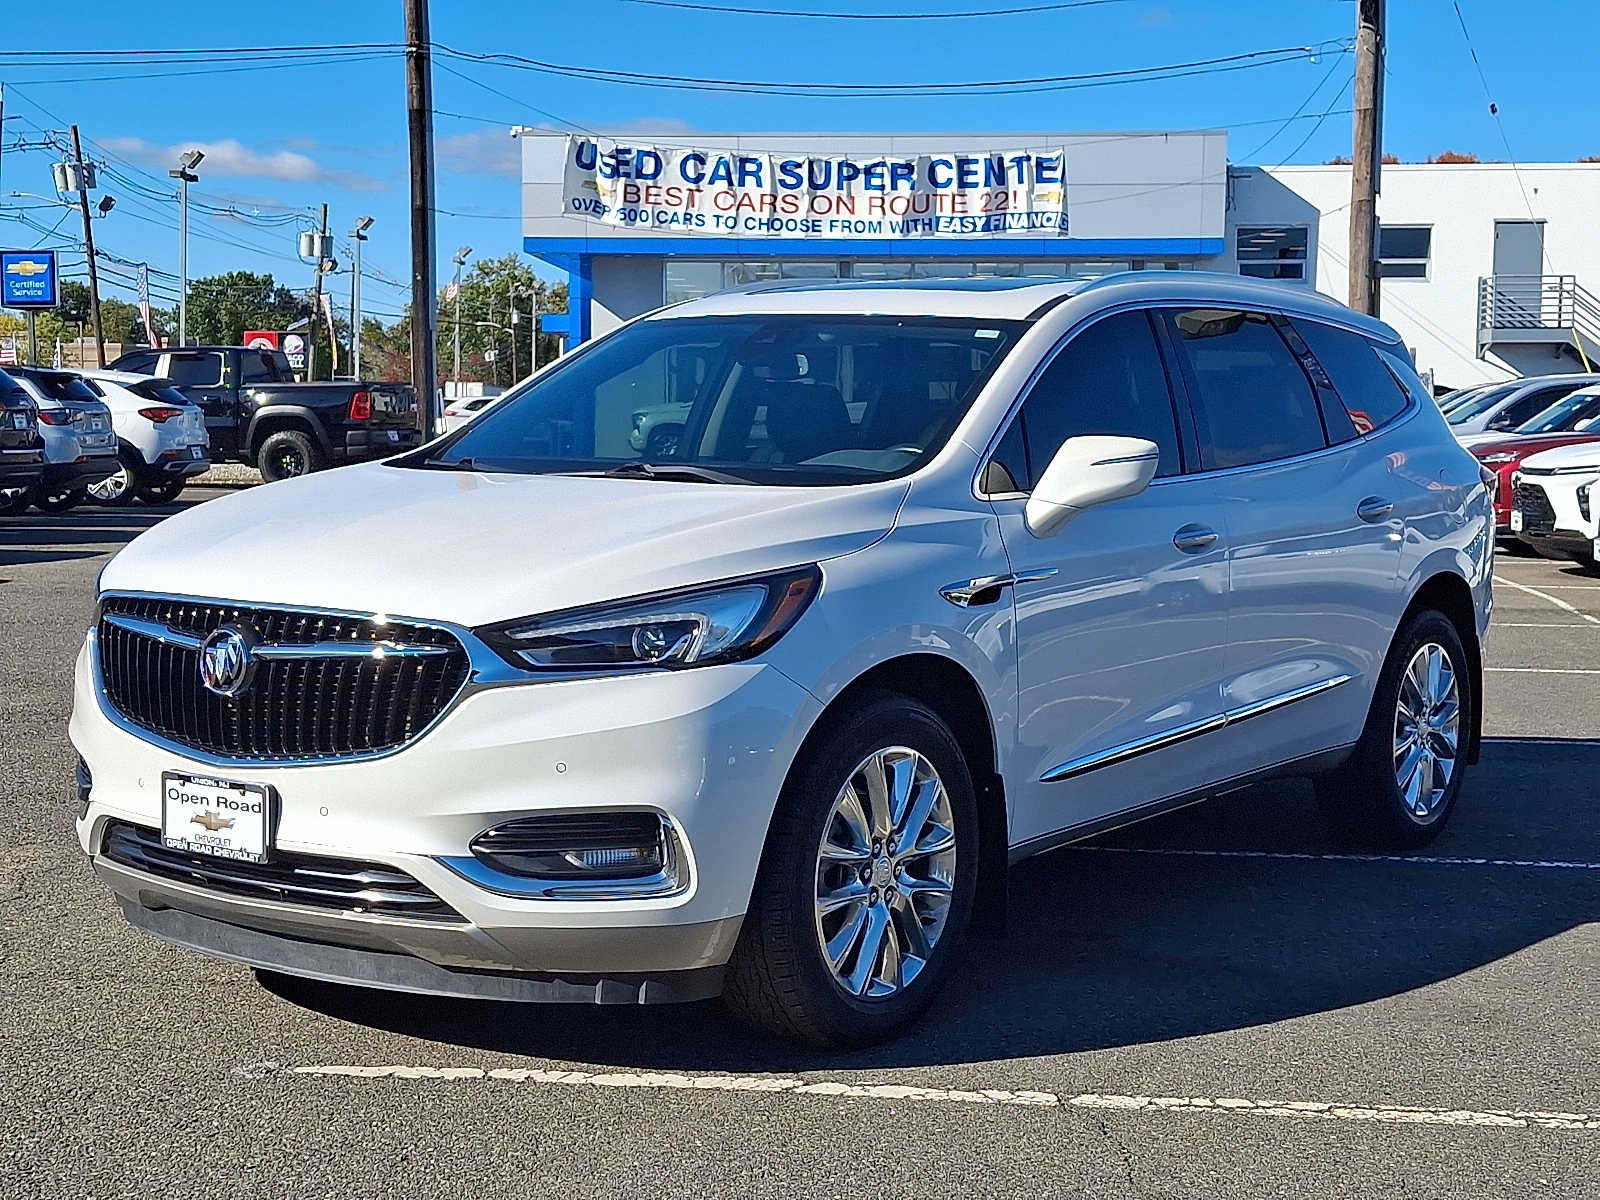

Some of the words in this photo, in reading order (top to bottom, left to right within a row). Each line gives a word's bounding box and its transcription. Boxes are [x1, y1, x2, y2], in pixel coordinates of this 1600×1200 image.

[575, 141, 662, 180] USED
[679, 153, 763, 188] CAR
[778, 158, 916, 191] SUPER
[927, 153, 1066, 188] CENTE
[623, 183, 704, 208] BEST
[713, 190, 800, 213] CARS
[810, 195, 855, 215] ON
[868, 193, 968, 216] ROUTE
[980, 190, 1018, 213] 22!
[656, 210, 705, 227] CARS
[713, 214, 737, 229] TO
[744, 217, 823, 232] CHOOSE
[829, 219, 882, 233] FROM
[889, 217, 933, 234] WITH
[937, 216, 987, 233] EASY
[9, 280, 45, 289] Certified
[12, 288, 43, 296] Service
[168, 788, 210, 806] Open
[216, 796, 262, 814] Road
[166, 838, 188, 850] OPEN
[189, 842, 213, 855] ROAD
[213, 846, 260, 863] CHEVROLET
